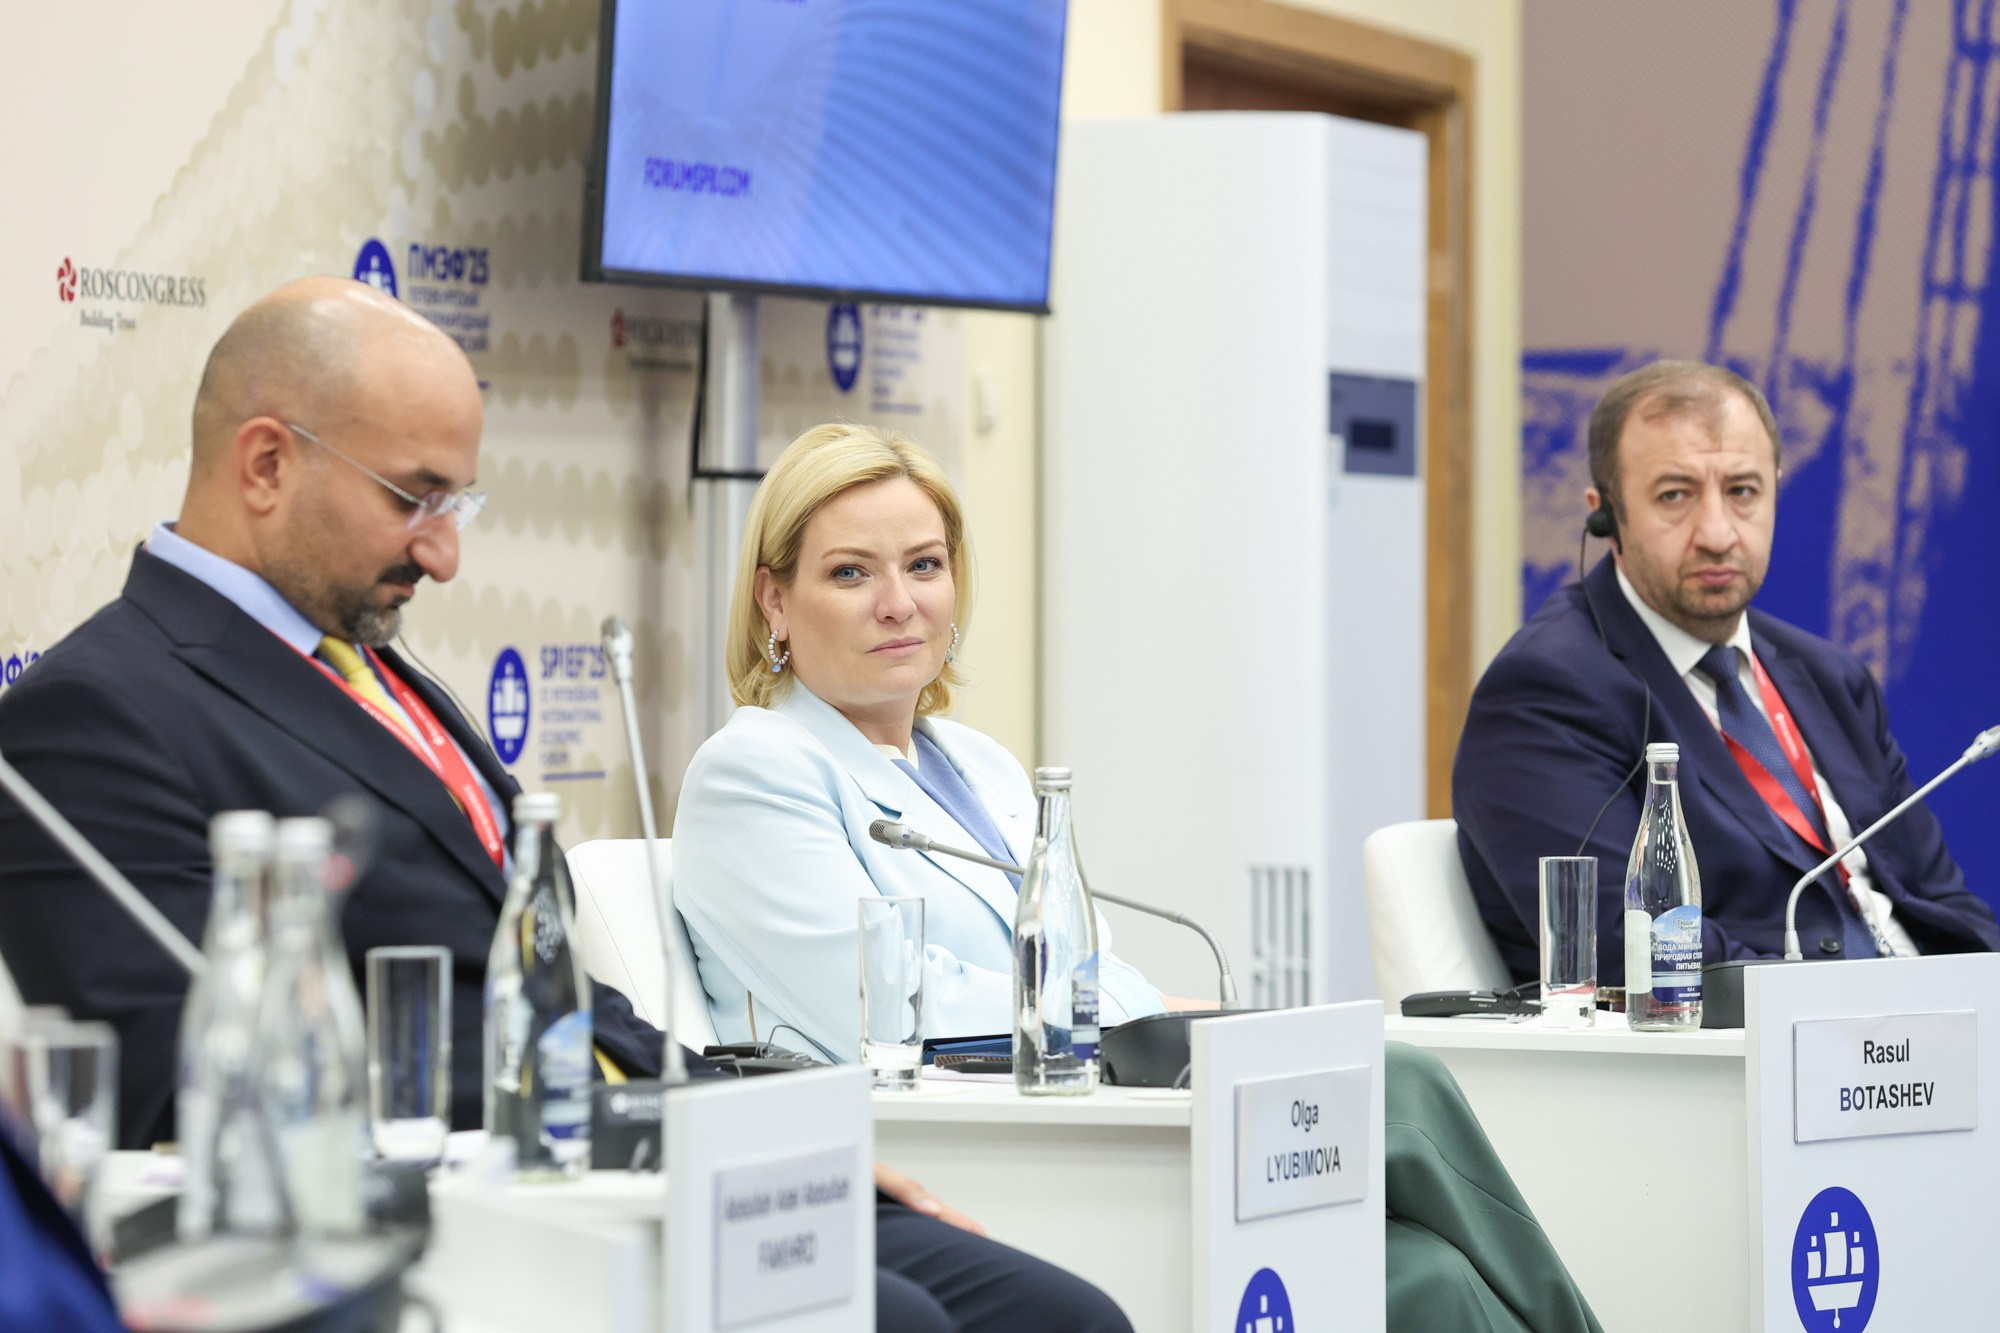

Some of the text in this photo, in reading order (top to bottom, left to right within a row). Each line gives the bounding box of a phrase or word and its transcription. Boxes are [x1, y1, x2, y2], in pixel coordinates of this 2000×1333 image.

[408, 244, 488, 285] ПМЭФ'25
[80, 267, 206, 307] ROSCONGRESS
[80, 309, 136, 333] Building Trust
[1654, 952, 1692, 962] ПРИРОДНАЯ
[1658, 943, 1677, 952] ВОДА
[1863, 1038, 1910, 1064] Rasul
[1840, 1081, 1935, 1112] BOTASHEV
[1291, 1100, 1319, 1133] Olga
[1267, 1146, 1341, 1184] LYUBIMOVA
